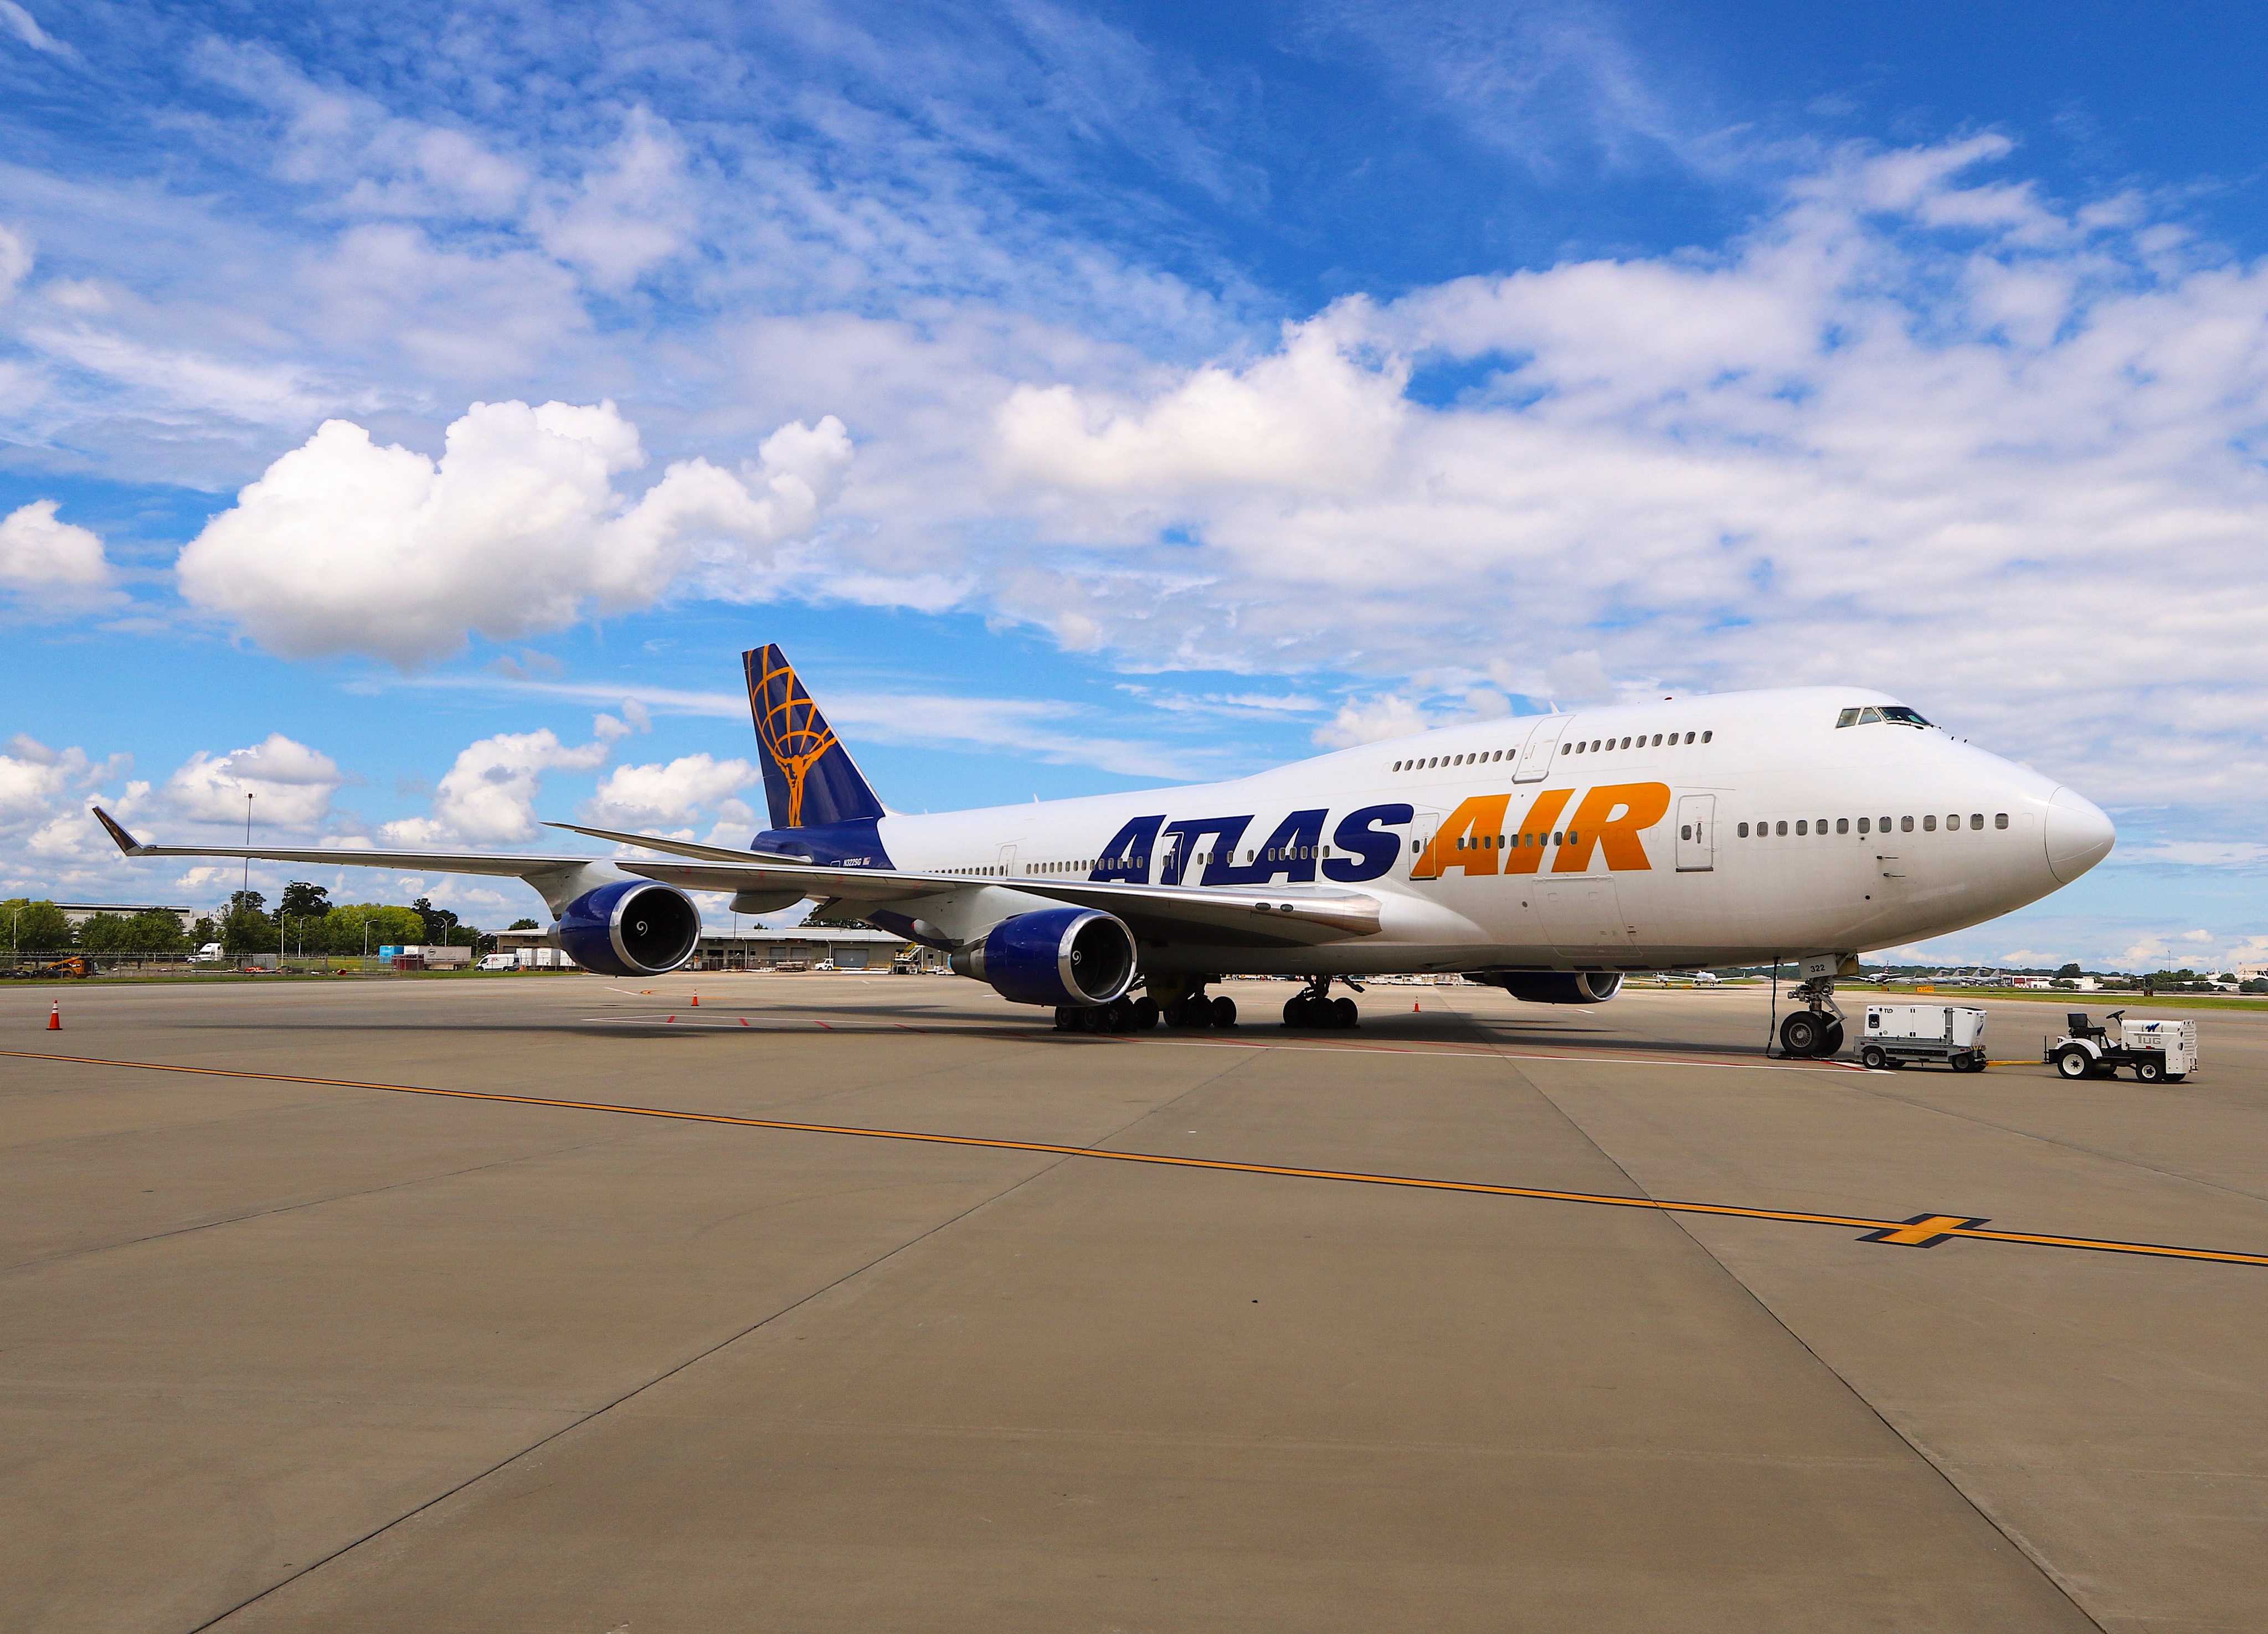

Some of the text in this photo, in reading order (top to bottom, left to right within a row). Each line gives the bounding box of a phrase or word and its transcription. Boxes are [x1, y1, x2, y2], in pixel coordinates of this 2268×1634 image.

[1088, 782, 1670, 886] ATLAS AIR
[843, 858, 862, 867] N322SG
[1810, 964, 1825, 972] 322
[2133, 1033, 2161, 1044] TUG
